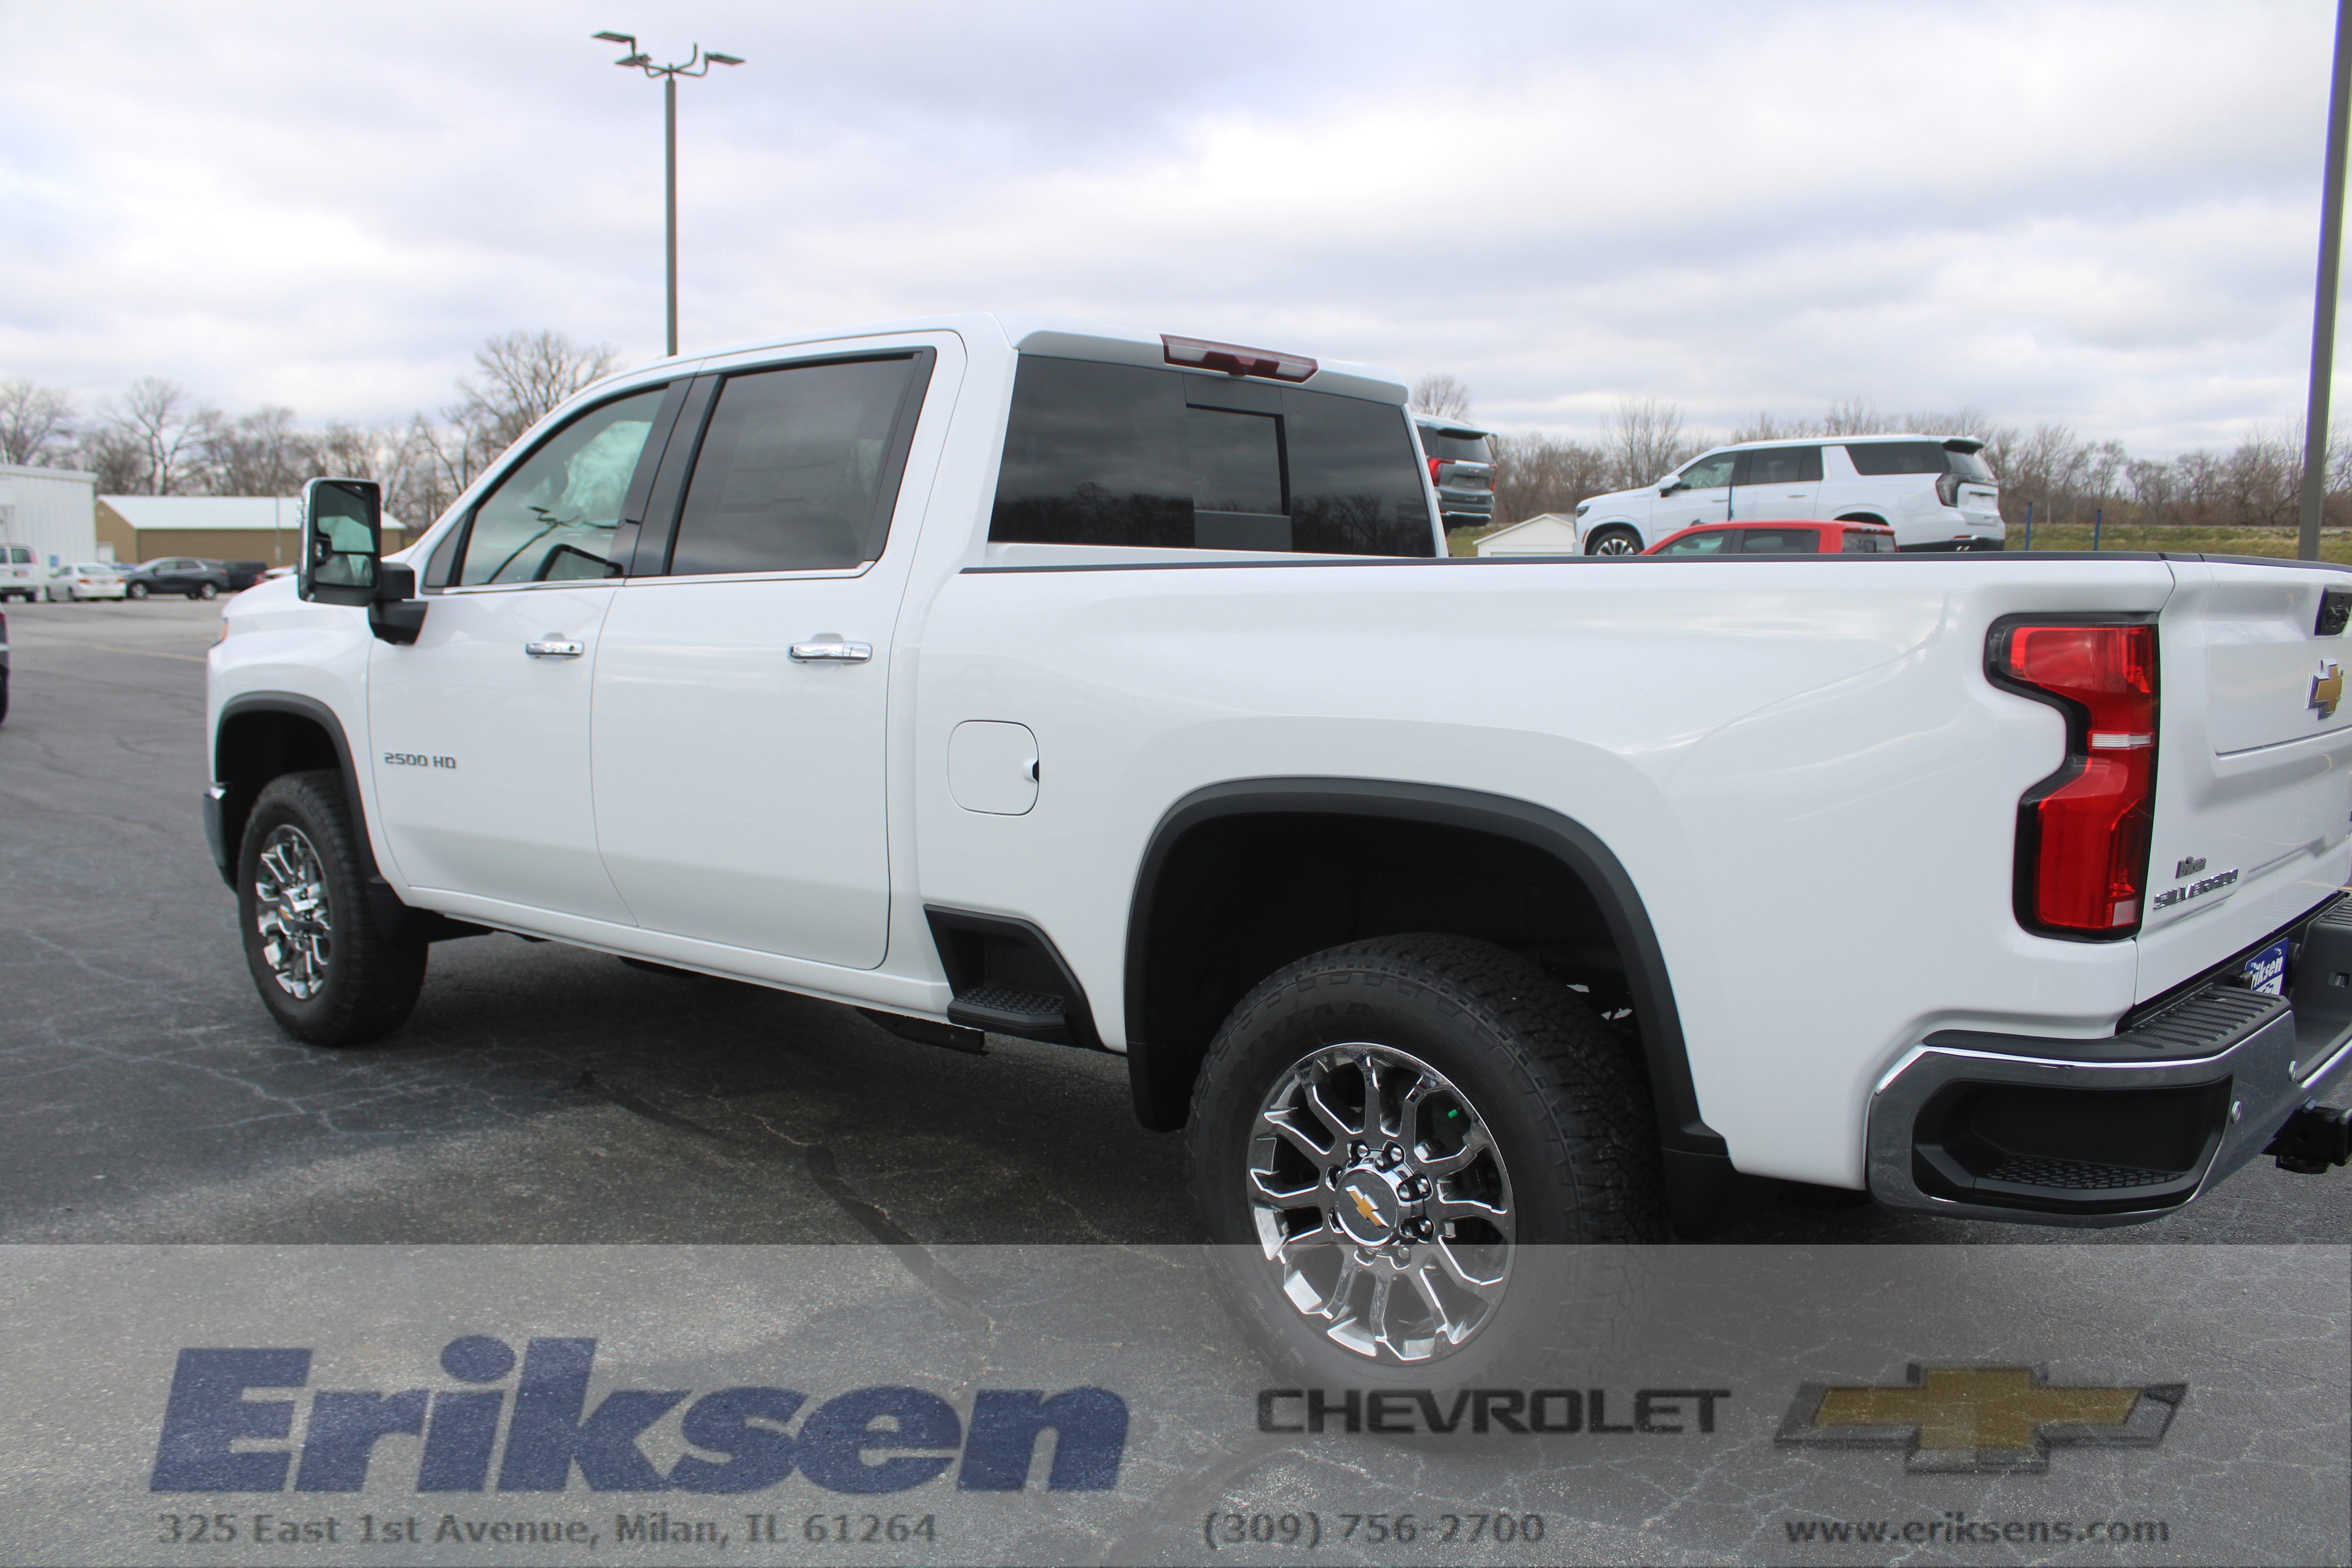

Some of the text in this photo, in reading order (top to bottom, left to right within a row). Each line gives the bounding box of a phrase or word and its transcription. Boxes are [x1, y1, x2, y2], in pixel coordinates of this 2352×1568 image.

[384, 752, 457, 769] 2500 HD
[2153, 868, 2238, 911] SILVERADO
[2250, 956, 2284, 991] riksen
